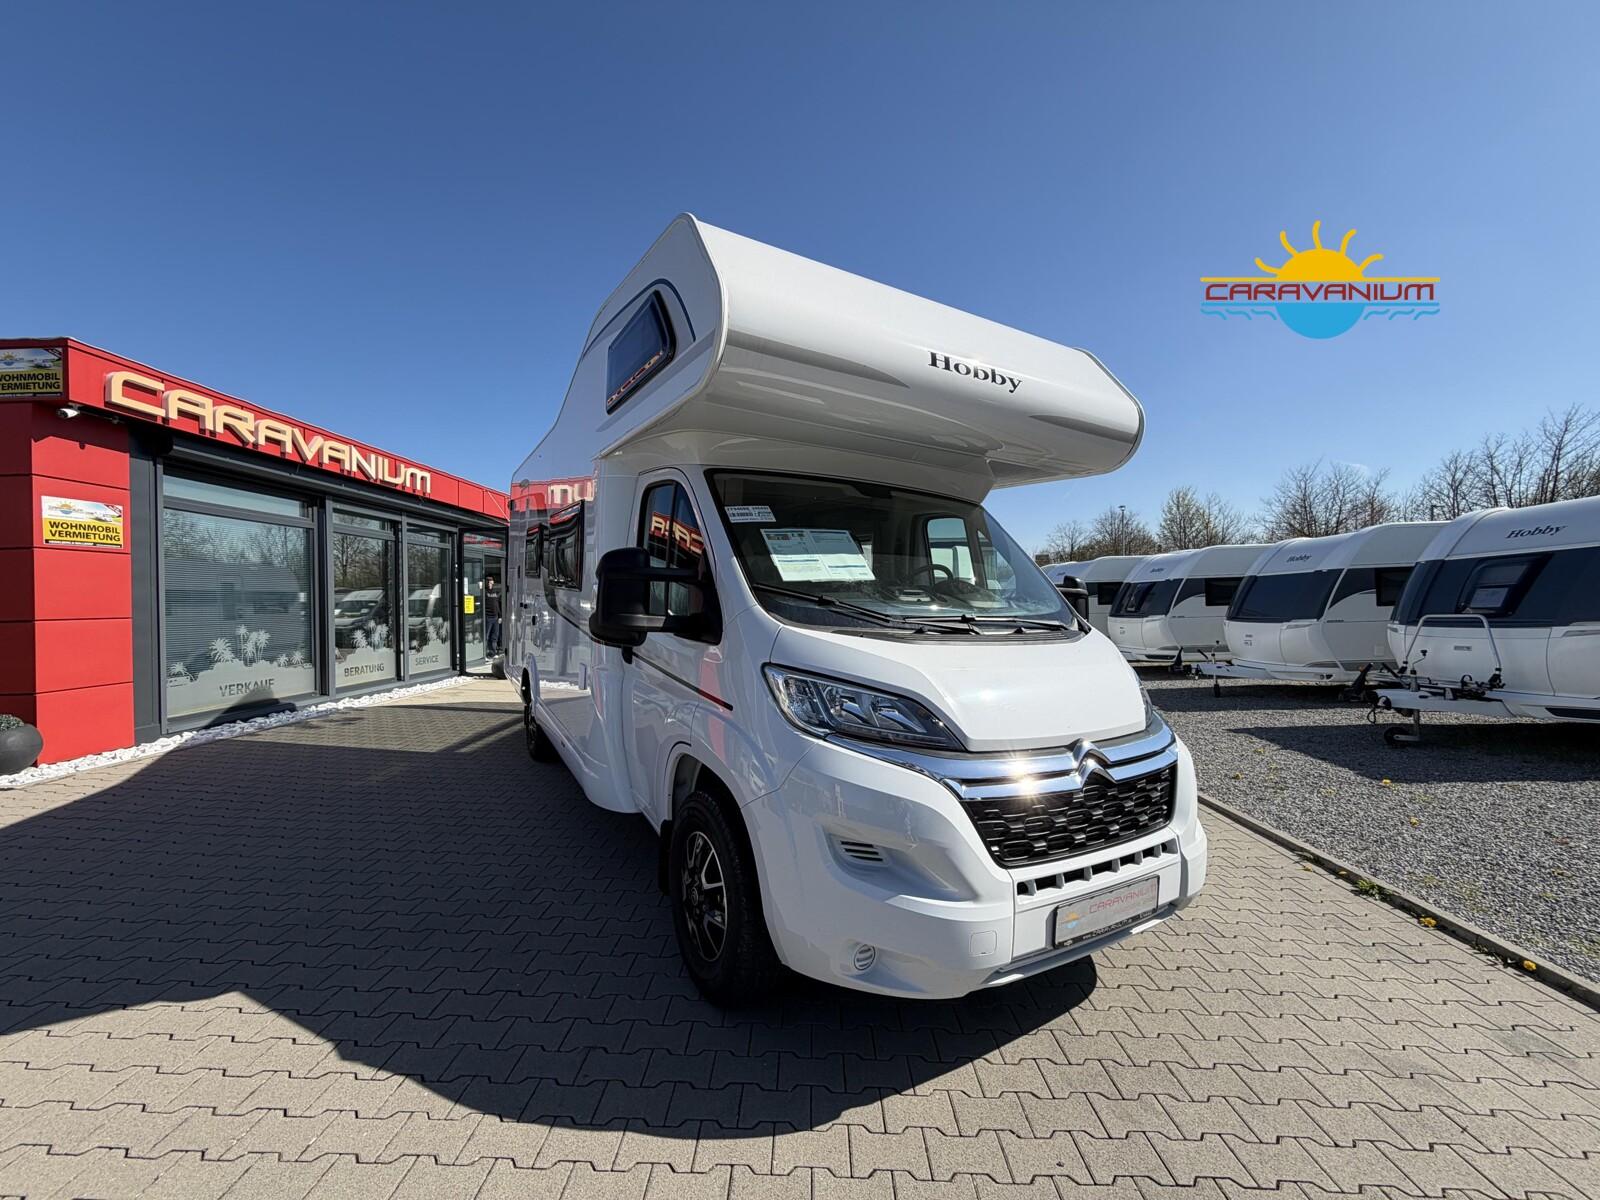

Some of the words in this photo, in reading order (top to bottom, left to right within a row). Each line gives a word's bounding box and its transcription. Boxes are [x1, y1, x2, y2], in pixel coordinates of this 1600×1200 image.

[928, 351, 1023, 393] Hobby
[0, 381, 60, 391] ERMIETUNG
[105, 371, 431, 494] CARAVANIUM
[49, 521, 121, 535] WOHNMOBIL
[1504, 525, 1568, 539] Hobby
[49, 529, 121, 542] VERMIETUNG
[415, 655, 439, 666] SERVICE
[344, 663, 385, 677] BERATUNG
[219, 678, 275, 697] VERKAUF
